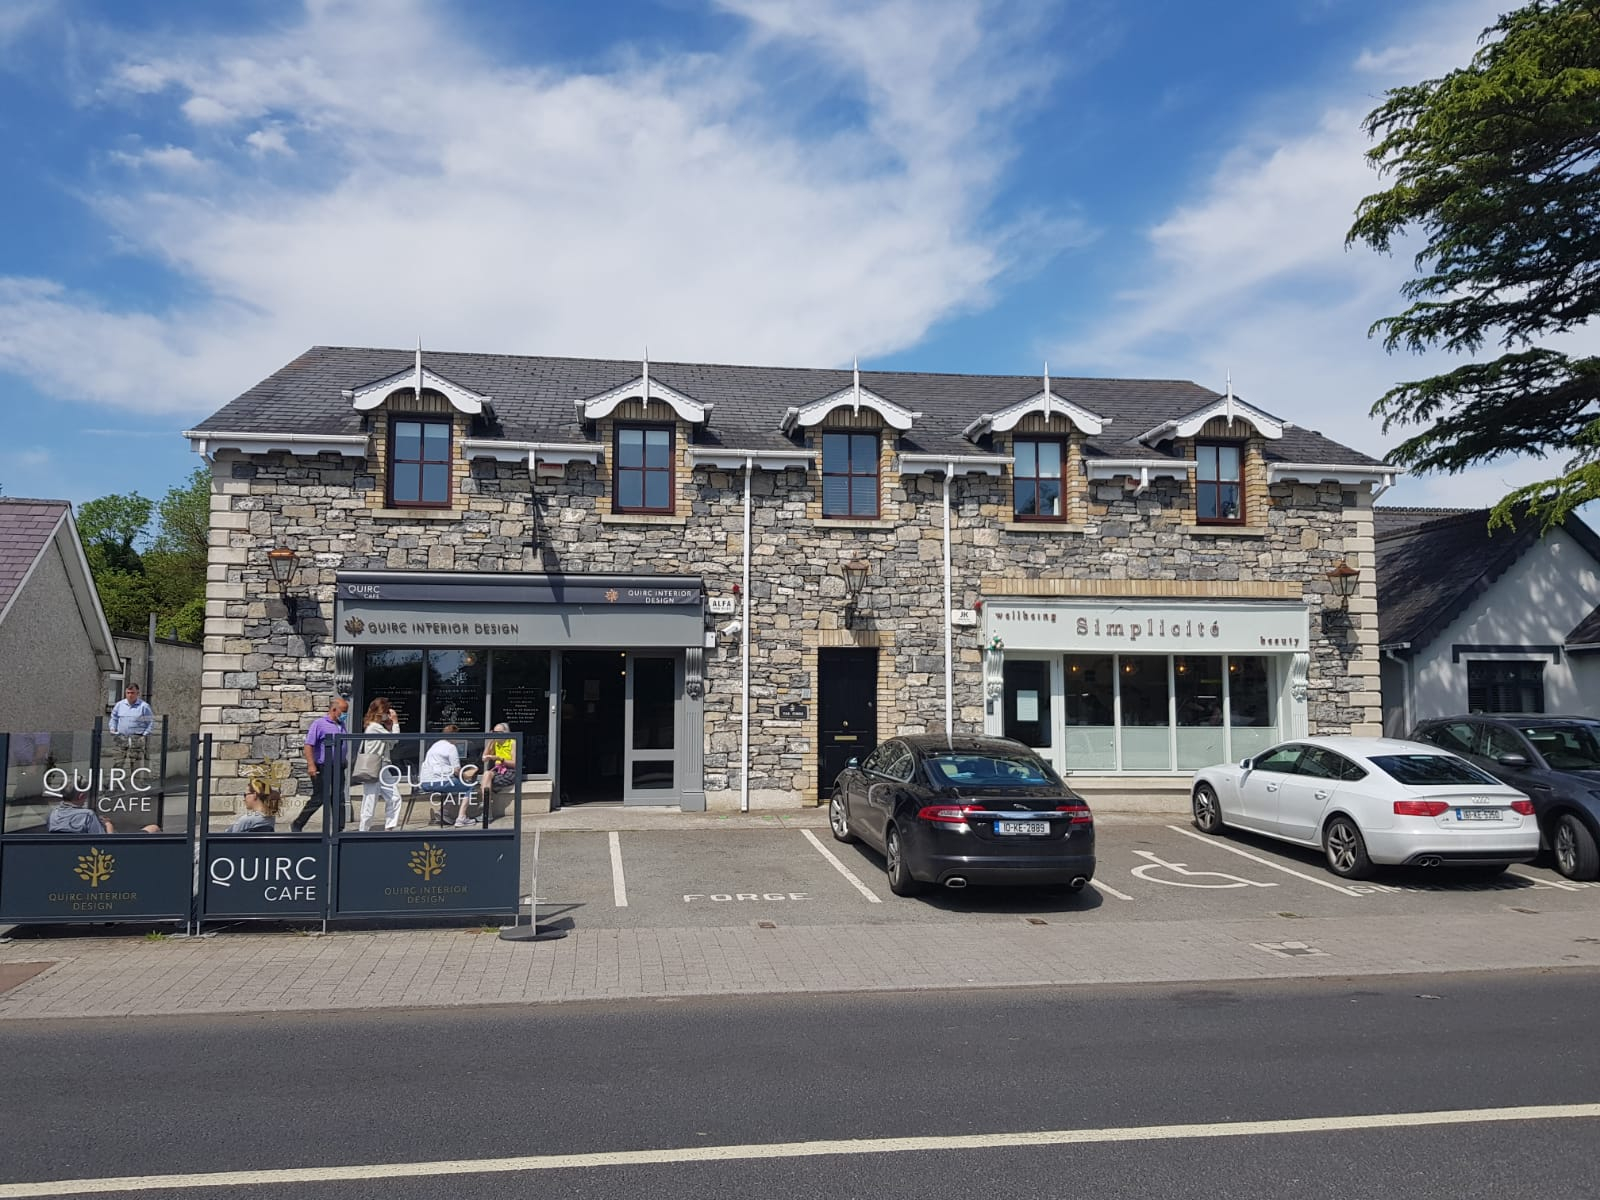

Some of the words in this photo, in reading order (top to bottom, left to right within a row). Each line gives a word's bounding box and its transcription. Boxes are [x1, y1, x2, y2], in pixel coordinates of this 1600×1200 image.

[348, 585, 381, 594] QUIRC
[995, 611, 1057, 623] wellbeing
[368, 622, 408, 634] QUIRC
[412, 623, 470, 635] INTERIOR
[474, 623, 519, 635] DESIGN
[1076, 617, 1220, 641] Simplicité
[1260, 636, 1300, 648] beauty
[43, 767, 152, 798] QUIRC
[429, 791, 479, 806] CAFE
[98, 797, 152, 813] CAFE
[210, 856, 317, 887] QUIRC
[49, 893, 83, 901] QUIRC
[86, 892, 137, 900] INTERIOR
[264, 886, 316, 901] CAFE
[384, 887, 417, 896] QUIRC
[420, 885, 468, 894] INTERIOR
[407, 895, 445, 904] DESIGN
[683, 892, 813, 903] FORGE
[73, 902, 113, 911] DESIGN
